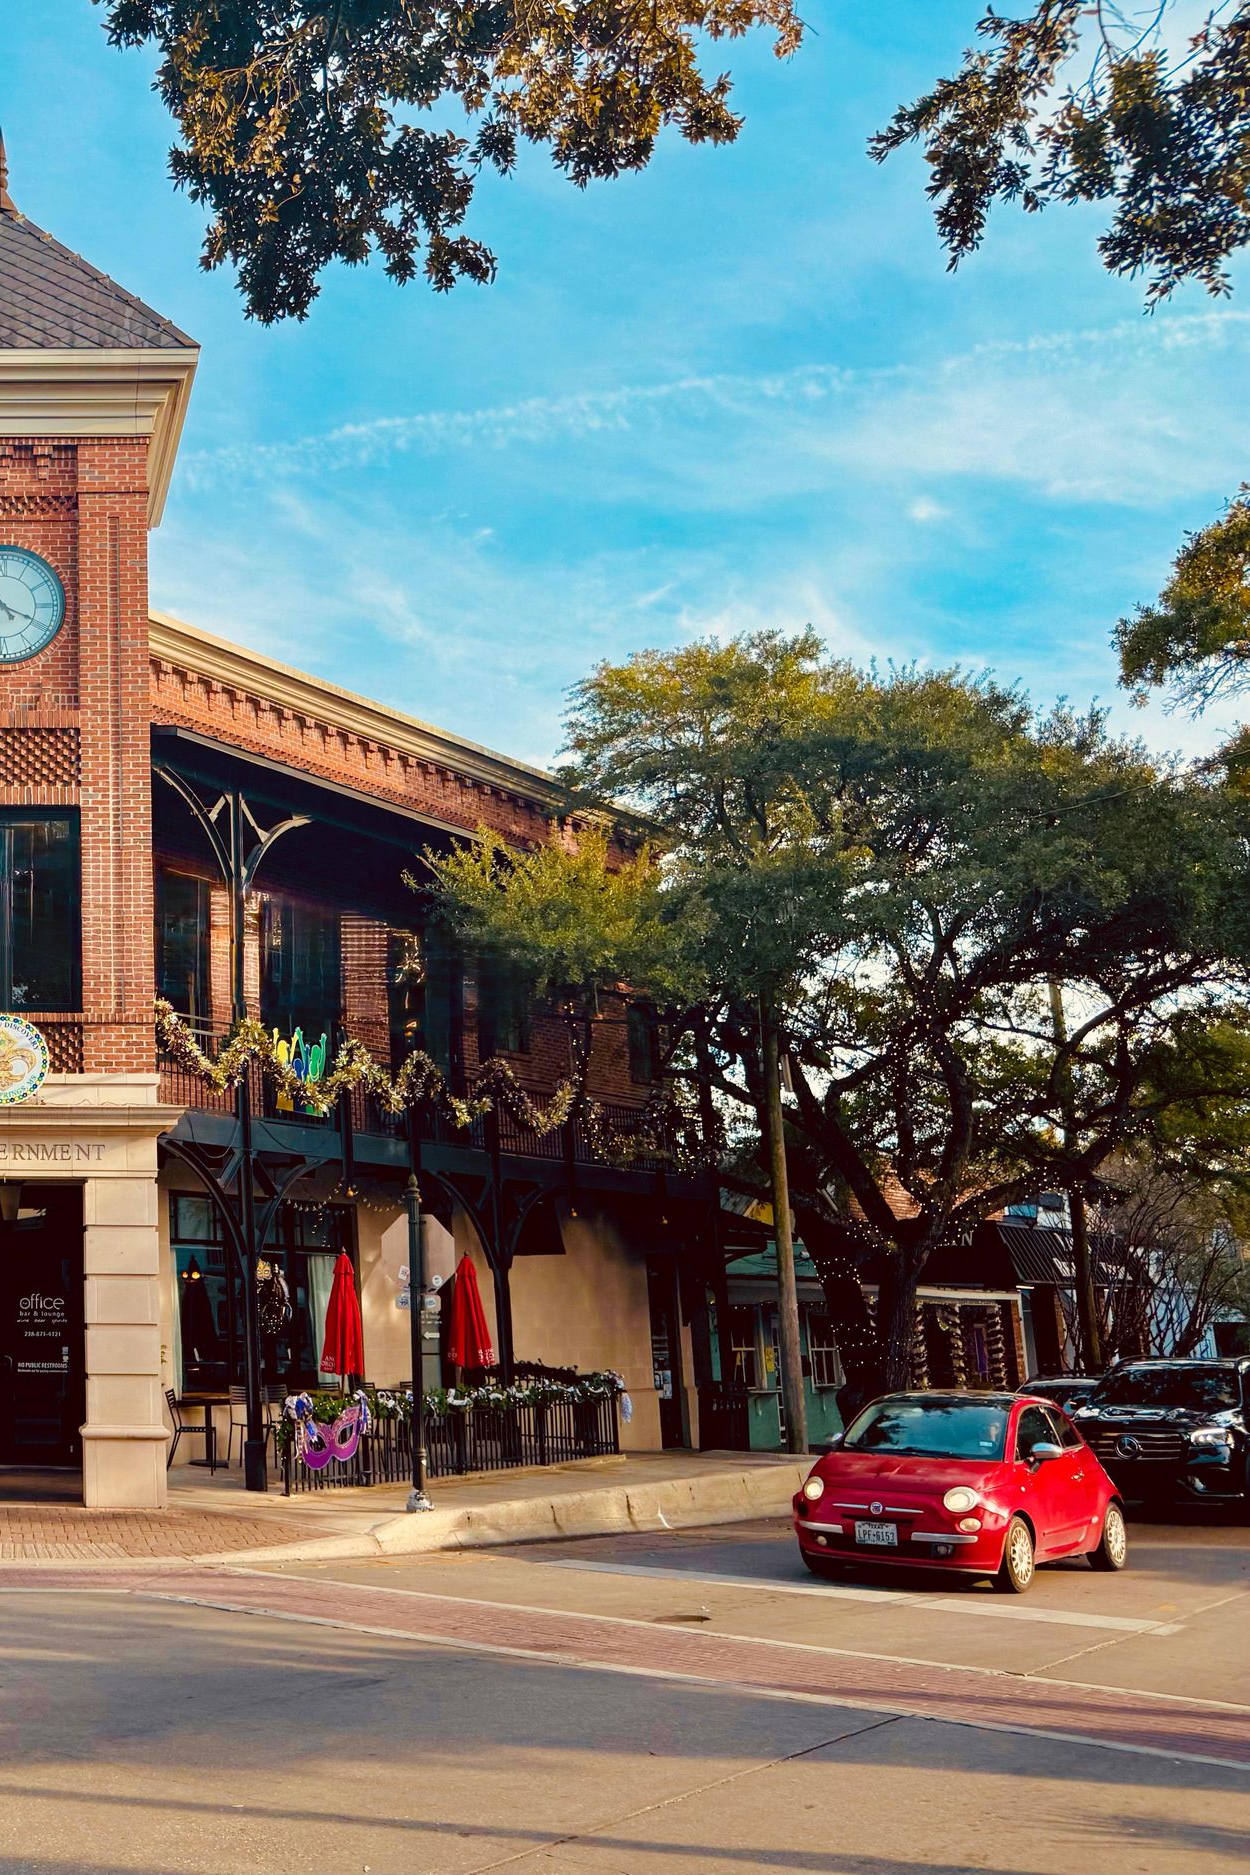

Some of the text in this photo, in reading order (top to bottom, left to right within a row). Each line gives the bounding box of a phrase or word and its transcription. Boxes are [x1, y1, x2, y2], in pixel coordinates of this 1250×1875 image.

[4, 1022, 40, 1051] DISCOVERY
[27, 1074, 37, 1086] MS
[19, 1293, 65, 1310] office
